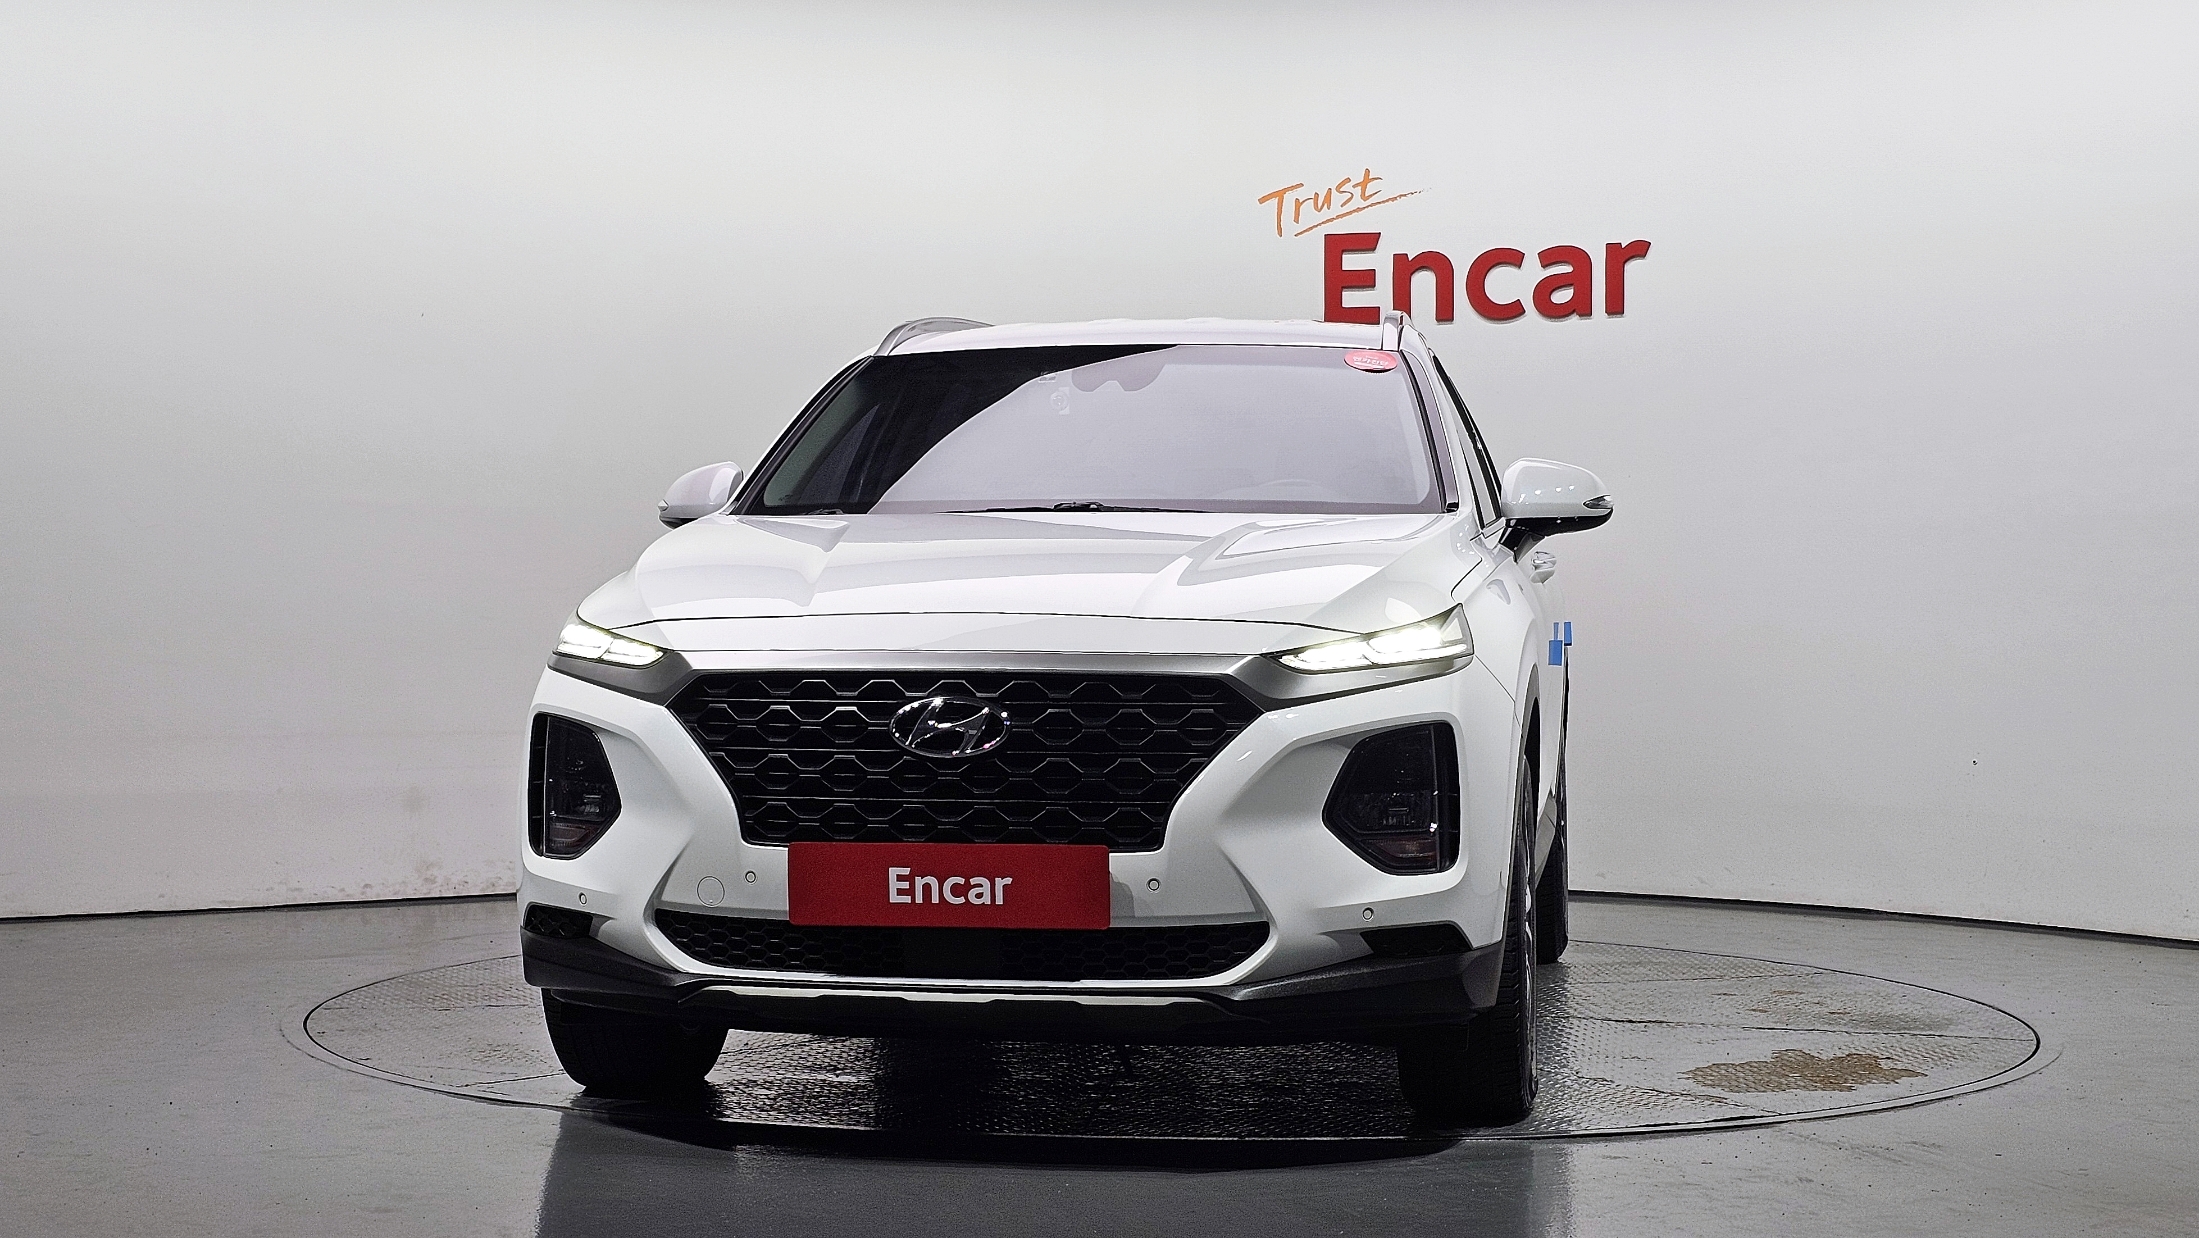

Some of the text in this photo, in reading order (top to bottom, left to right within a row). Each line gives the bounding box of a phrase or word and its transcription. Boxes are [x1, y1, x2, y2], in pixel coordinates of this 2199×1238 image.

[1258, 168, 1383, 237] Trust
[1324, 232, 1651, 323] Encar
[888, 867, 1013, 905] Encar
